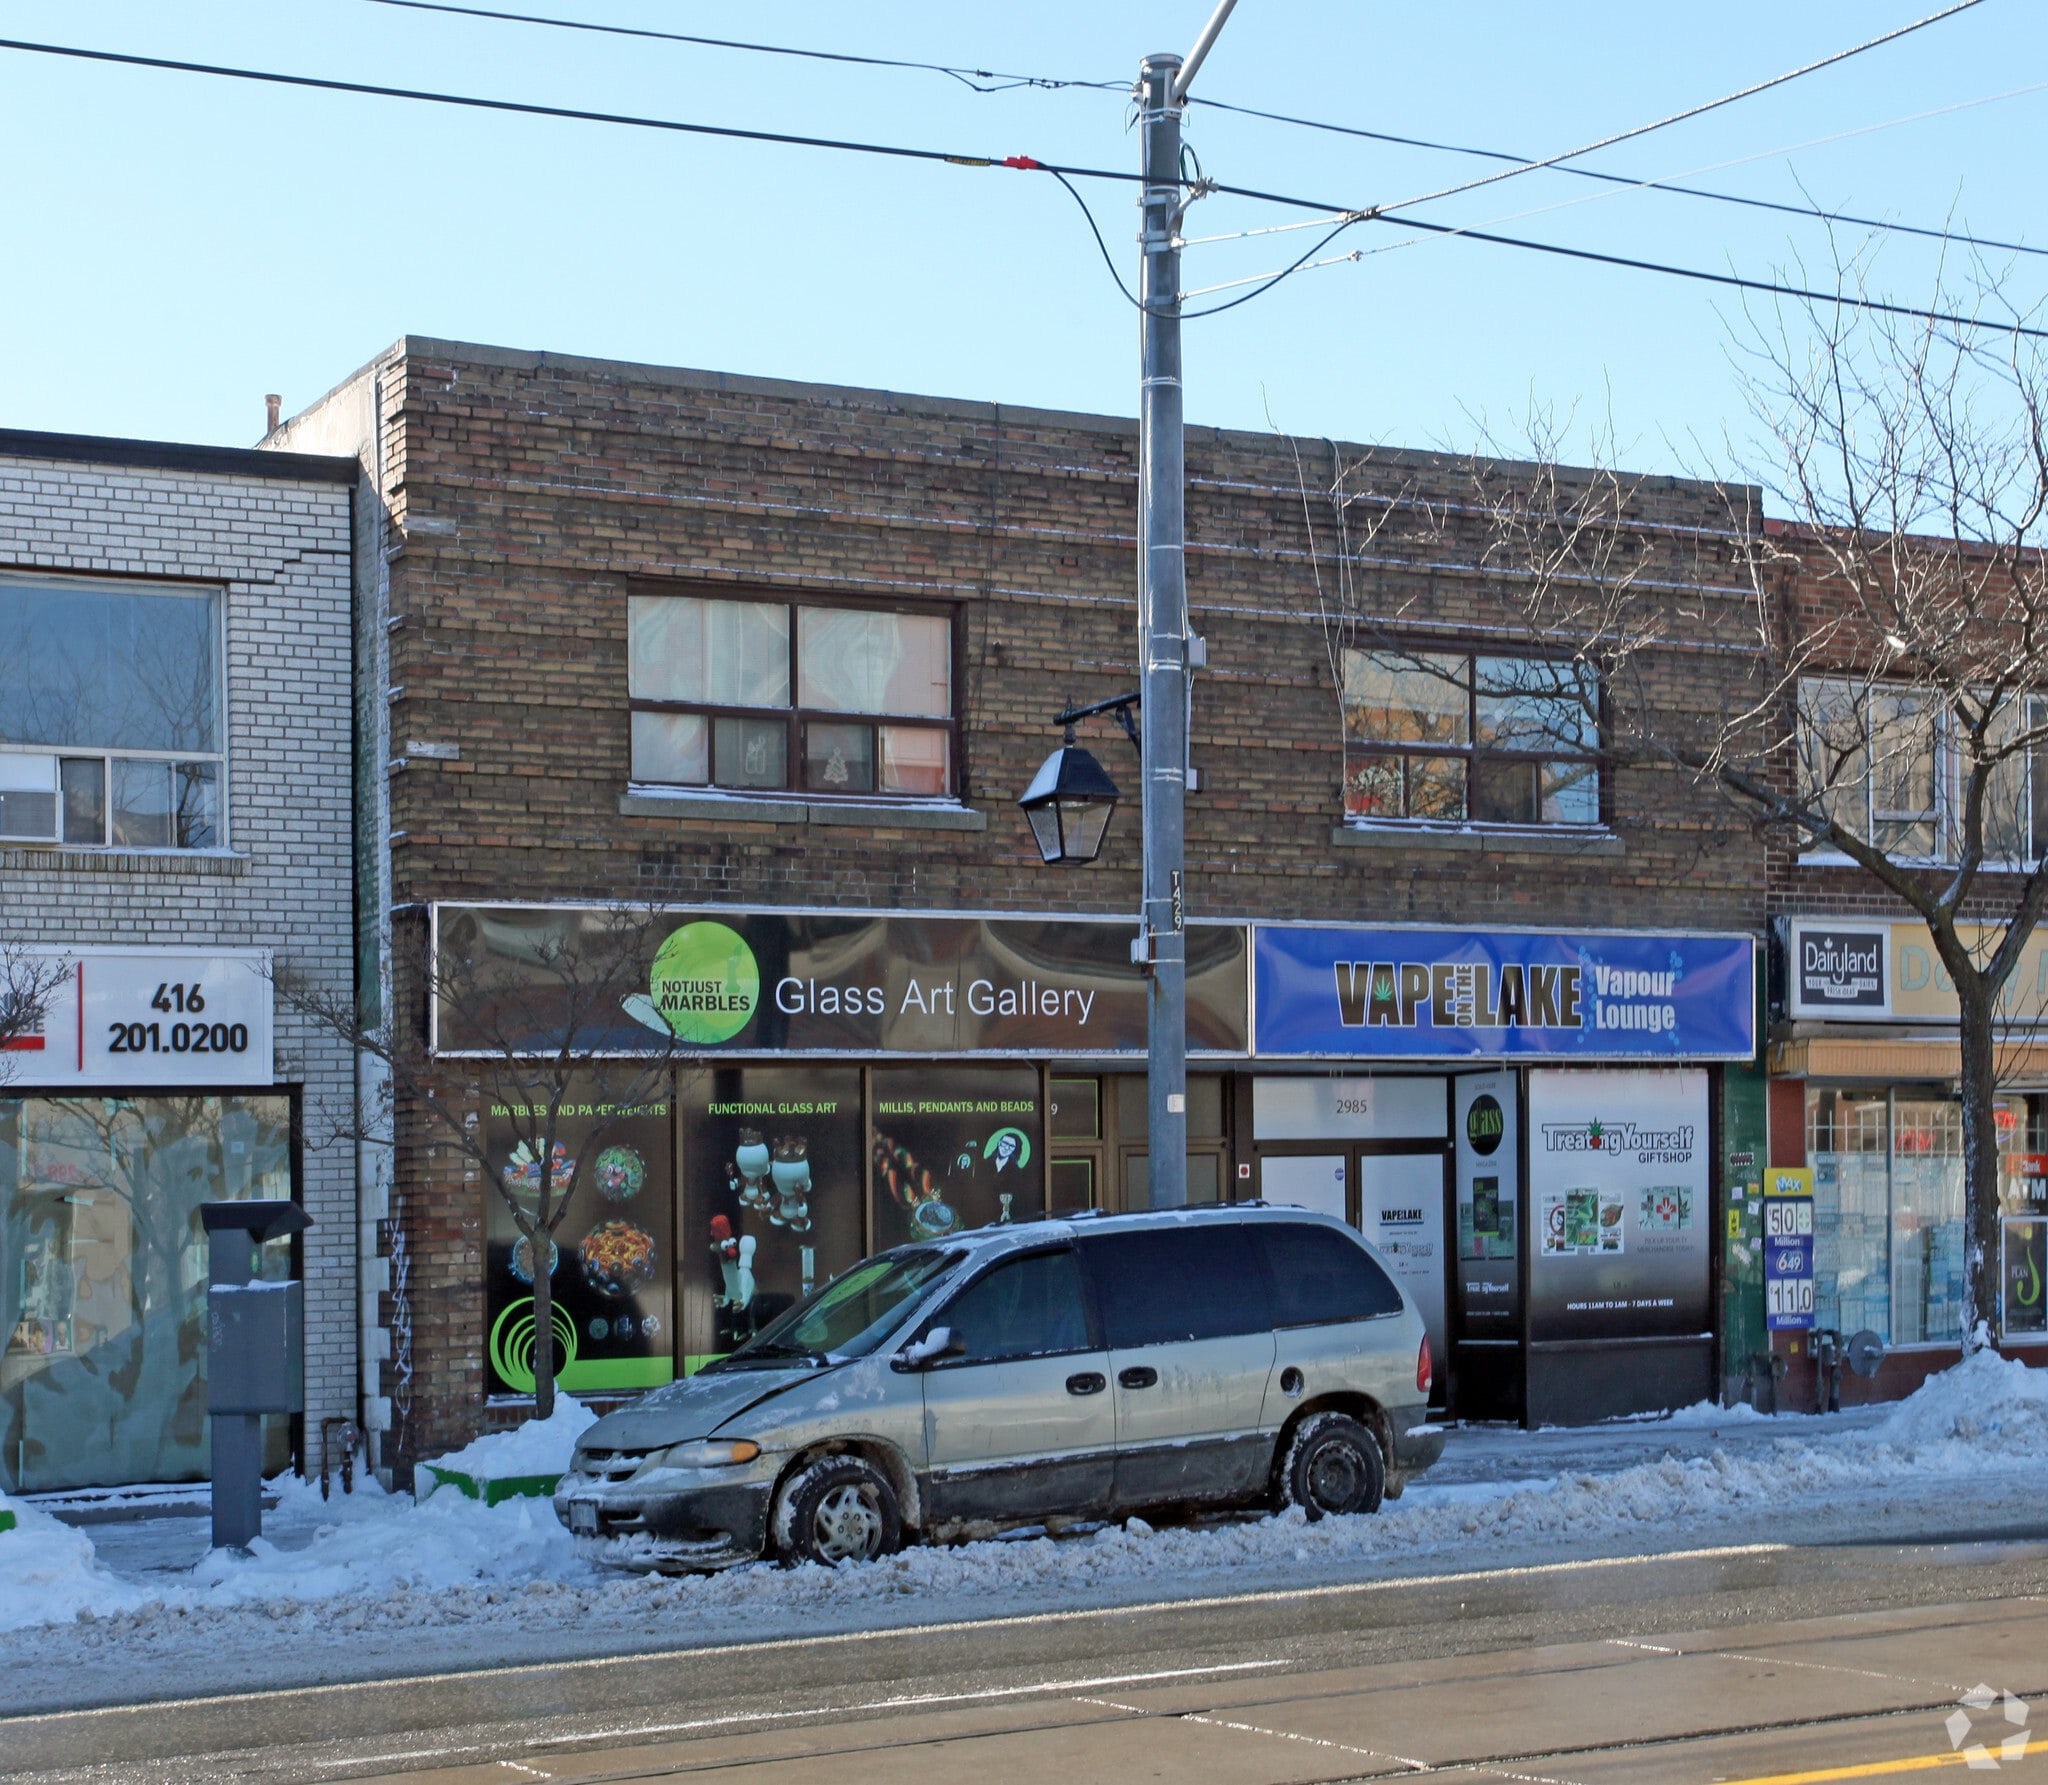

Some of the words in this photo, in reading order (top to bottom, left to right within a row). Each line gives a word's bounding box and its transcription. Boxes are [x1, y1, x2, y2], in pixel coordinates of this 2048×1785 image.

[1805, 938, 1877, 984] Dairyland
[1456, 966, 1472, 998] THE
[1596, 966, 1676, 999] Vapour
[150, 983, 205, 1013] 416
[662, 995, 750, 1011] MARBLES
[775, 977, 886, 1014] Glass
[900, 978, 954, 1014] Art
[968, 979, 1095, 1025] Gallery
[1334, 961, 1456, 1028] VAPE
[1473, 962, 1582, 1028] LAKE
[1456, 1002, 1472, 1026] ON
[1596, 1000, 1676, 1033] Lounge
[108, 1022, 248, 1053] 201.0200
[556, 1104, 575, 1116] ND
[708, 1103, 776, 1114] FUNCTIONAL
[778, 1102, 814, 1114] GLASS
[816, 1102, 838, 1114] ART
[880, 1102, 916, 1114] MILLIS,
[918, 1102, 974, 1113] PENDANTS
[976, 1102, 998, 1112] AND
[1000, 1100, 1034, 1112] BEADS
[1336, 1100, 1367, 1114] 2985
[1638, 1152, 1692, 1164] GIFTSHOP
[1776, 1176, 1802, 1192] MAX
[2007, 1178, 2046, 1200] ATM
[1382, 1210, 1401, 1221] VAPE
[1404, 1208, 1422, 1220] LAKE
[1774, 1237, 1800, 1246] Million
[1776, 1316, 1802, 1326] Million
